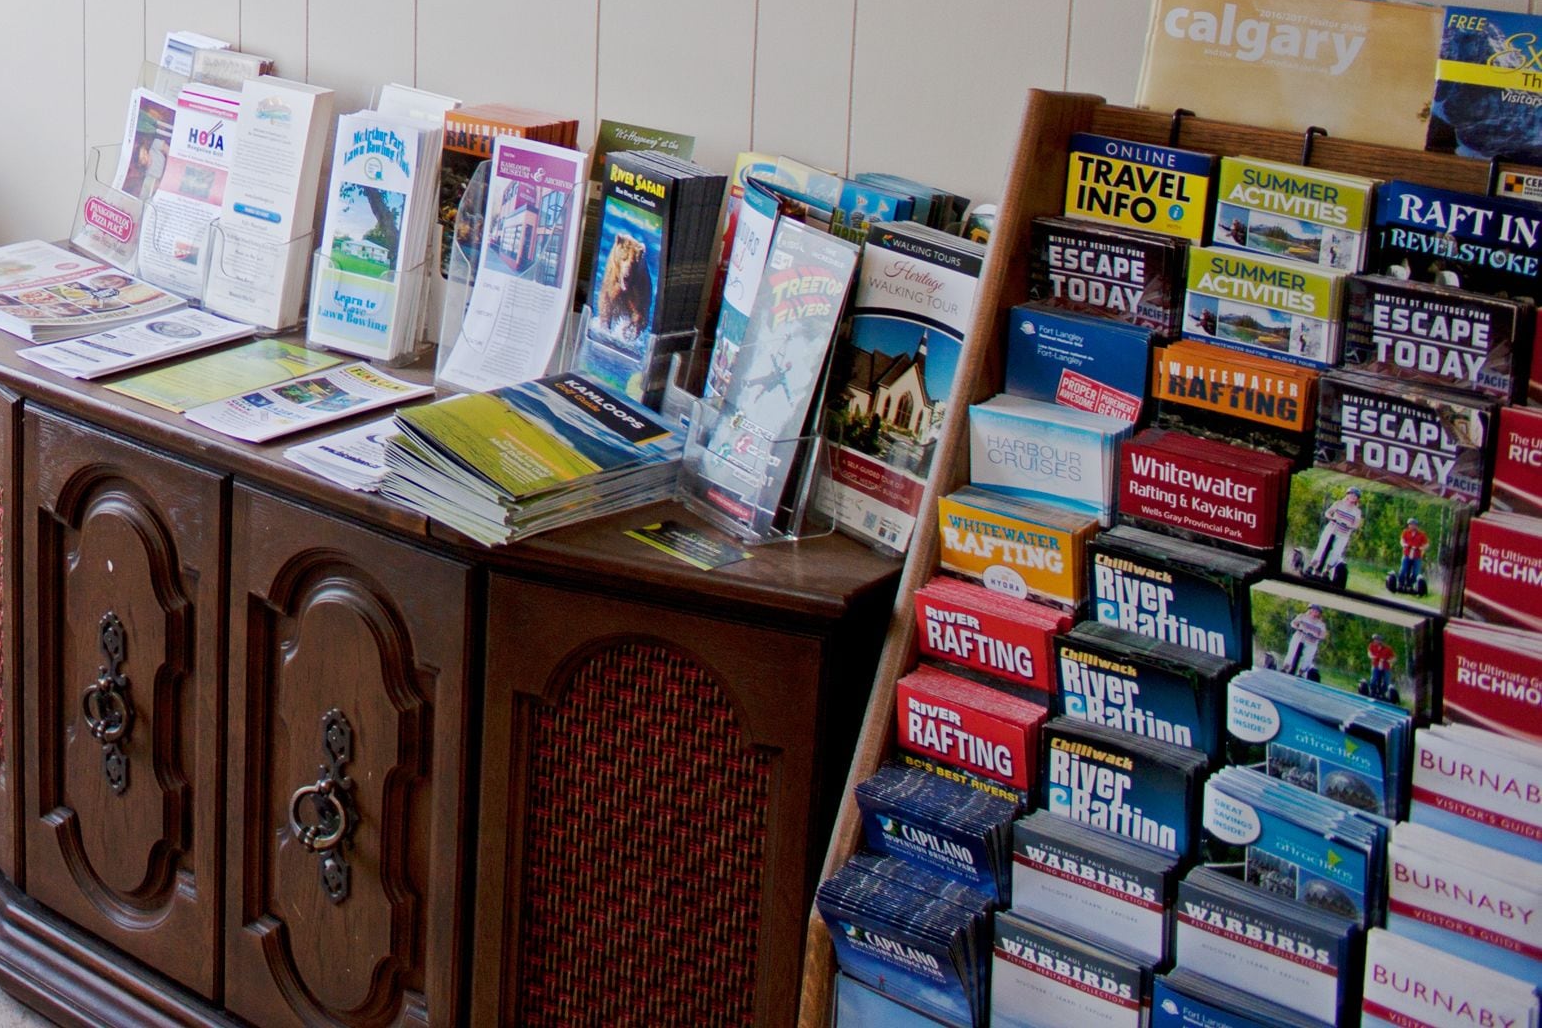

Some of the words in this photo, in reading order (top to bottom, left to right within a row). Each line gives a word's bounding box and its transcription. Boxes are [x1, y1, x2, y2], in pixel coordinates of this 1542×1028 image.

[1164, 3, 1366, 76] calgary
[1447, 14, 1487, 32] FREE
[188, 127, 224, 151] HOJA
[1105, 142, 1176, 168] ONLINE
[1077, 155, 1190, 203] TRAVEL
[1242, 168, 1339, 204] SUMMER
[1076, 184, 1157, 224] INFO
[1229, 183, 1348, 225] ACTIVITIES
[1399, 192, 1494, 236] RAFT
[1499, 213, 1540, 249] IN
[892, 238, 932, 258] WALKING
[933, 250, 962, 267] TOURS
[1048, 245, 1145, 285] ESCAPE
[1049, 235, 1076, 246] WINTER
[1090, 241, 1124, 255] HERITAGE
[1127, 249, 1146, 259] PARK
[1391, 227, 1539, 277] REVELSTOKE
[772, 275, 843, 308] TREETOP
[869, 276, 924, 304] WALKING
[884, 259, 945, 293] Heritage
[1197, 273, 1316, 313] ACTIVITIES
[1210, 257, 1306, 292] SUMMER
[334, 290, 363, 306] Learn
[1049, 273, 1145, 315] TODAY
[1374, 293, 1407, 306] WINTER
[1410, 299, 1420, 308] AT
[1423, 302, 1465, 316] HERITAGE
[1469, 309, 1491, 321] PARK
[772, 302, 833, 332] FLYERS
[1038, 325, 1055, 337] Fort
[1055, 329, 1084, 343] Langley
[1373, 304, 1490, 349] ESCAPE
[1037, 347, 1083, 366] Fort-Langley
[1372, 335, 1487, 382] TODAY
[1061, 377, 1098, 401] PROPER
[1168, 374, 1299, 422] RAFTING
[1169, 361, 1299, 398] WHITEWATER
[564, 379, 645, 429] KAMLOOPS
[1059, 388, 1095, 411] AWESOME
[1100, 393, 1136, 414] PUREMENT
[1342, 394, 1375, 408] WINTER
[987, 434, 1082, 466] HARBOUR
[1509, 432, 1529, 447] The
[987, 449, 1082, 482] CRUISES
[1130, 452, 1257, 504] Whitewater
[1341, 435, 1456, 485] TODAY
[1129, 480, 1177, 509] Rafting
[1179, 493, 1188, 508] &
[1191, 496, 1257, 528] Kayaking
[1141, 504, 1163, 518] Wells
[1163, 510, 1183, 524] Gray
[1183, 516, 1223, 533] Provincial
[1224, 526, 1243, 539] Park
[942, 526, 1064, 575] RAFTING
[948, 514, 1061, 551] WHITEWATER
[1479, 542, 1499, 557] The
[1094, 553, 1172, 584] Chilliwack
[1094, 563, 1174, 617] River
[925, 605, 981, 630] RIVER
[926, 619, 1034, 679] RAFTING
[1060, 646, 1138, 678] Chilliwack
[1060, 657, 1140, 710] River
[1457, 655, 1476, 670] The
[1478, 660, 1528, 685] Ultimate
[908, 697, 961, 726] RIVER
[1232, 694, 1262, 710] GREAT
[1232, 706, 1273, 725] SAVINGS
[908, 712, 1013, 778] RAFTING
[1233, 719, 1265, 733] INSIDE!
[1050, 737, 1133, 771] Chilliwack
[1295, 733, 1371, 768] attractions
[904, 755, 933, 772] BC'S
[936, 765, 967, 786] BEST
[970, 778, 1020, 804] RIVERS!
[1050, 748, 1132, 802] River
[1420, 748, 1542, 804] BURNAB
[1213, 808, 1253, 830] SAVINGS
[1214, 798, 1243, 816] GREAT
[1435, 796, 1496, 825] VISITOR'S
[901, 824, 974, 865] CAPILANO
[1213, 818, 1246, 838] INSIDE!
[883, 832, 927, 856] SUSPENSION
[928, 849, 955, 868] BRIDGE
[956, 860, 978, 874] PARK
[1039, 843, 1085, 863] EXPERIENCE
[1088, 857, 1106, 870] PAUL
[1109, 866, 1139, 882] ALLEN'S
[1275, 840, 1353, 880] attractions
[1025, 845, 1155, 902] WARBIRDS
[1031, 861, 1058, 876] FLYING
[1060, 870, 1099, 890] HERITAGE
[1100, 884, 1150, 909] COLLECTION
[1394, 862, 1535, 926] BURNABY
[1184, 901, 1330, 965] WARBIRDS
[1201, 900, 1251, 922] EXPERIENCE
[1254, 918, 1275, 932] PAUL
[1277, 927, 1312, 944] ALLEN'S
[1413, 908, 1475, 937] VISITOR'S
[1479, 929, 1523, 953] GUIDE
[846, 934, 892, 961] SUSPENSION
[894, 953, 921, 970] BRIDGE
[922, 963, 945, 979] PARK
[864, 930, 939, 970] CAPILANO
[1015, 935, 1060, 957] EXPERIENCE
[1063, 954, 1081, 967] PAUL
[1084, 962, 1115, 979] ALLEN'S
[1190, 919, 1220, 935] FLYING
[1223, 929, 1265, 951] HERITAGE
[1267, 945, 1324, 971] COLLECTION
[1001, 936, 1132, 999] WARBIRDS
[1006, 953, 1034, 970] FLYING
[1036, 966, 1074, 986] HERITAGE
[1075, 980, 1126, 1006] COLLECTION
[1183, 1006, 1200, 1019] Fort
[1373, 963, 1516, 1028] BURNABY
